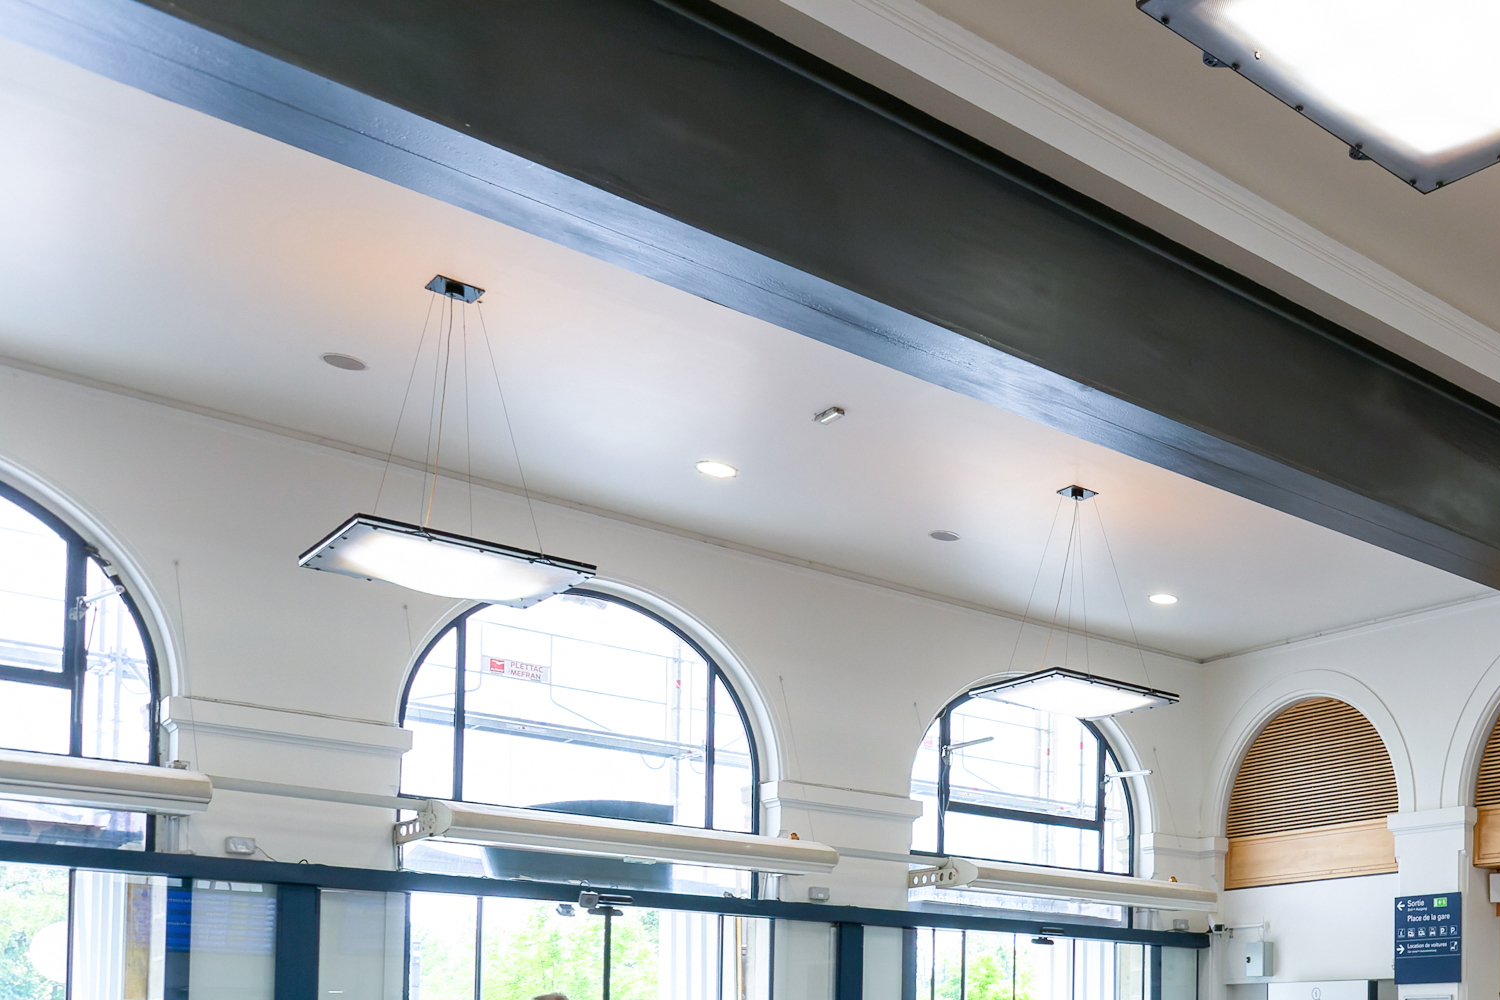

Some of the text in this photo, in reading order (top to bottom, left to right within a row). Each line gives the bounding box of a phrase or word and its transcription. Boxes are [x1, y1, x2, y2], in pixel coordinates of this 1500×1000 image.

[510, 662, 543, 673] PLETTAC
[510, 670, 541, 680] MEFRAN
[1407, 899, 1424, 907] Sortie
